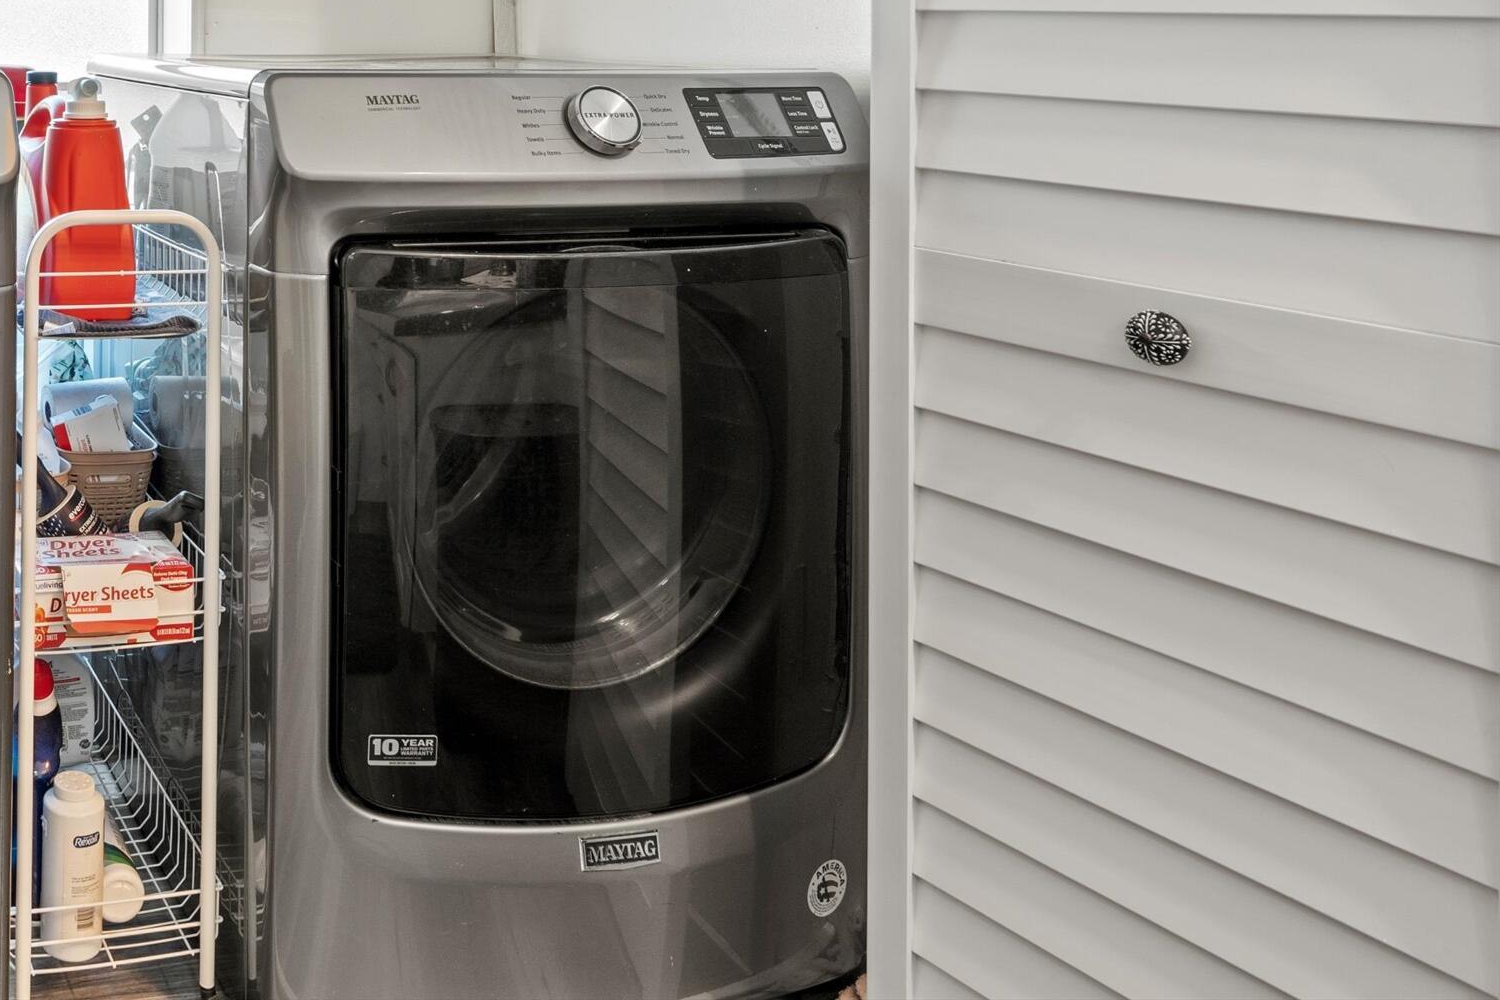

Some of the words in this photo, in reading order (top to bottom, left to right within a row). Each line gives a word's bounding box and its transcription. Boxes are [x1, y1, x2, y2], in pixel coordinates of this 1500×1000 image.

[365, 94, 420, 105] MAYTAG
[609, 111, 635, 119] POWER
[49, 539, 116, 551] Dryer
[42, 547, 121, 558] Sheets
[35, 582, 63, 590] ueliving
[64, 590, 98, 606] ryer
[101, 586, 154, 601] Sheets
[372, 738, 400, 756] 10
[401, 738, 434, 747] YEAR
[587, 840, 657, 864] MAYTAG
[816, 861, 845, 887] AMERICA
